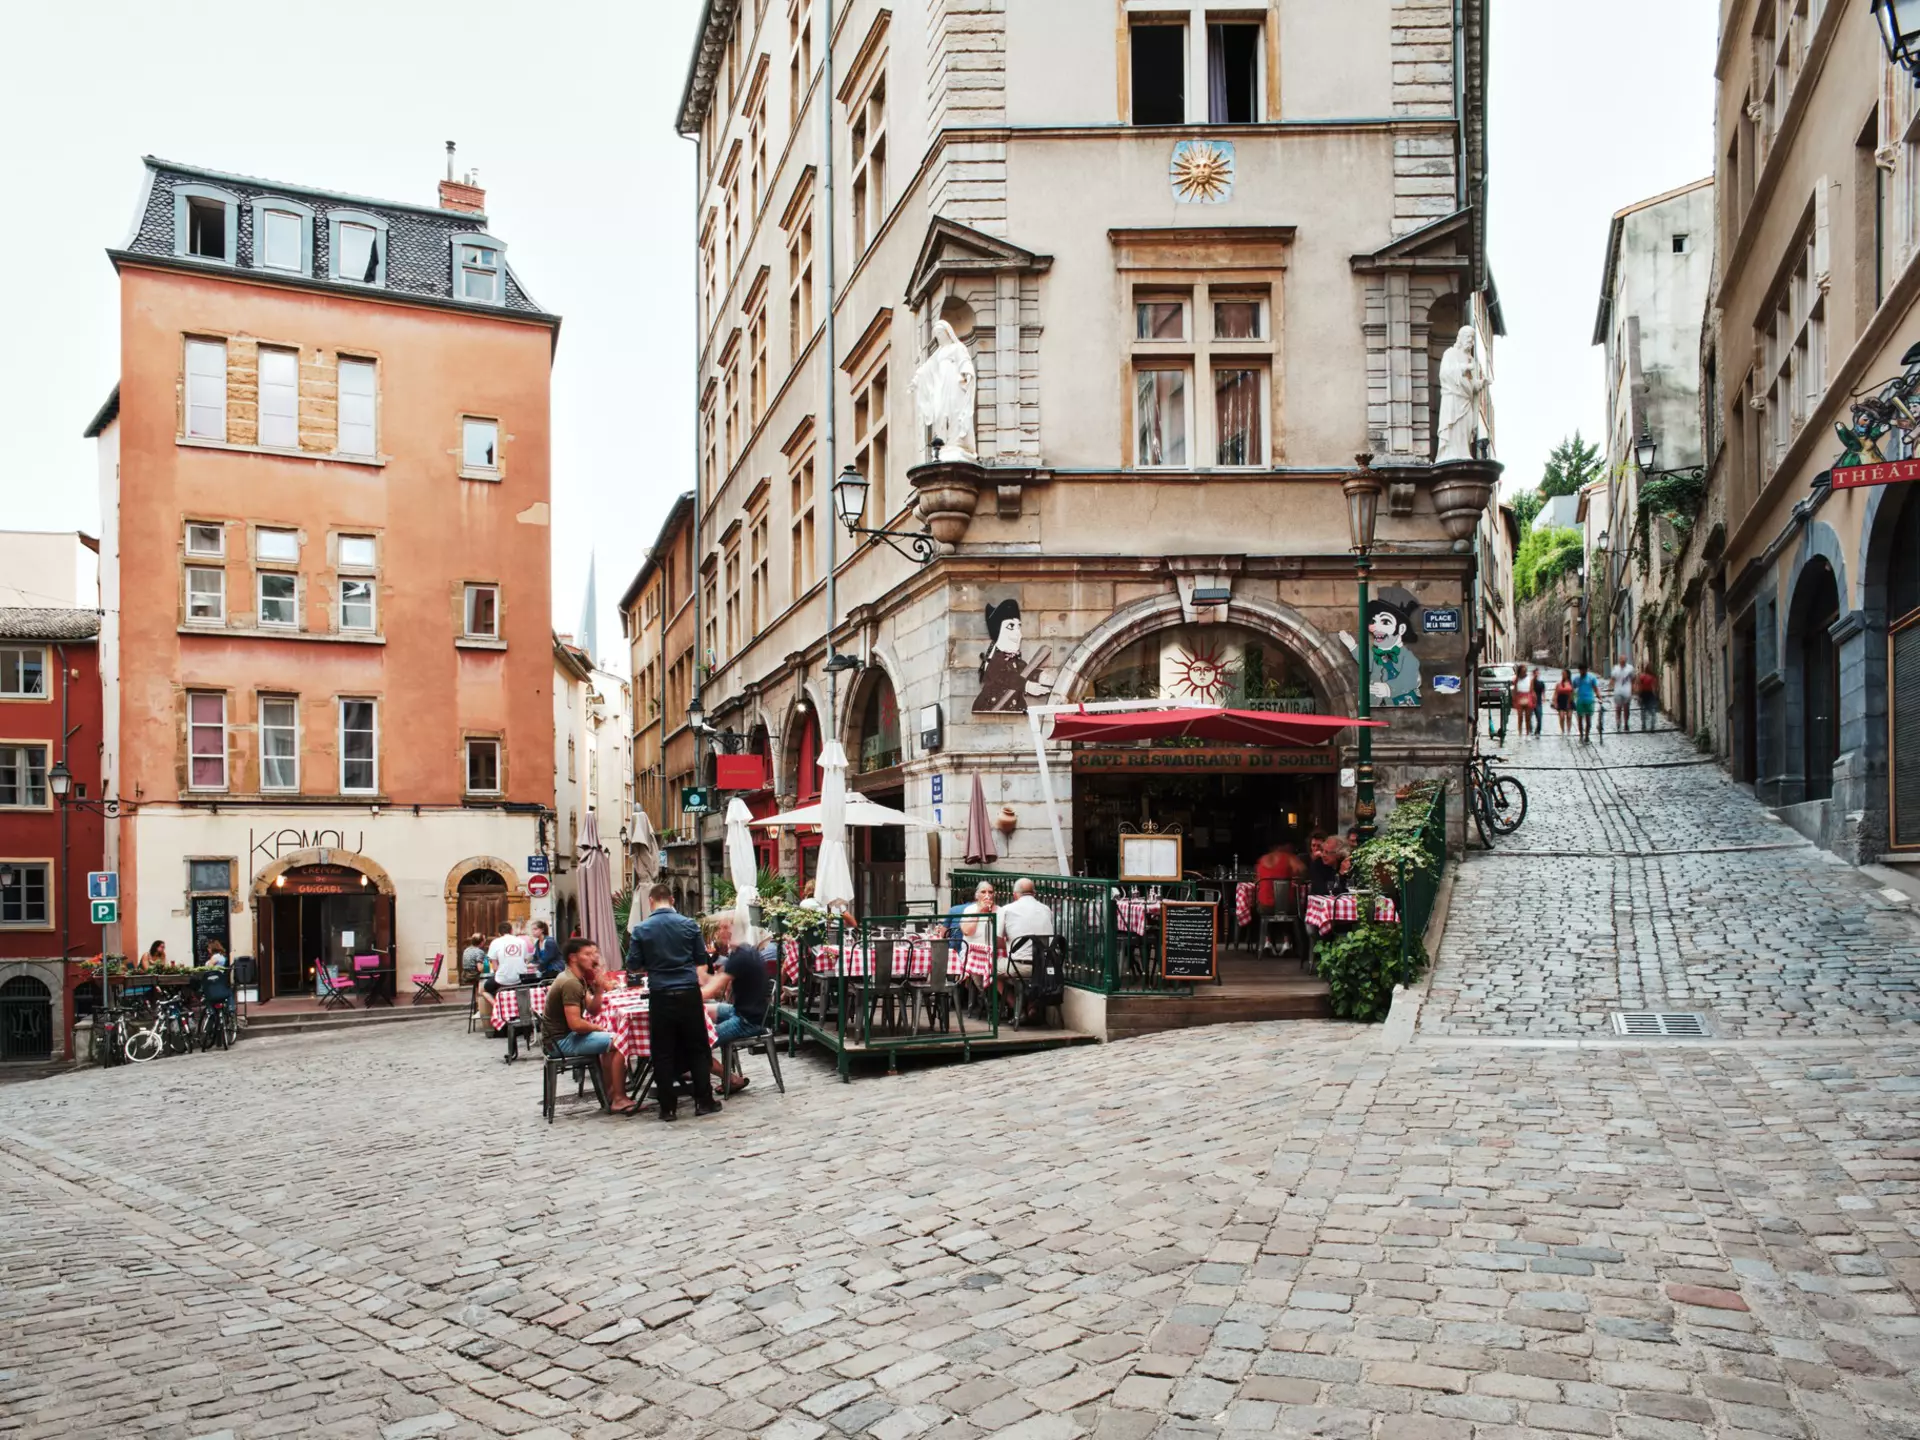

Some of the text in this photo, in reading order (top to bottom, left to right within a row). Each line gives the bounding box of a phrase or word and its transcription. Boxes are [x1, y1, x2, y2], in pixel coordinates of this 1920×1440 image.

[1834, 463, 1918, 484] THÉÂT
[1430, 614, 1452, 622] PLACE
[1127, 754, 1241, 767] RESTAURANT
[1248, 754, 1272, 767] DU
[1278, 754, 1333, 767] SOLEIL
[98, 905, 109, 918] P
